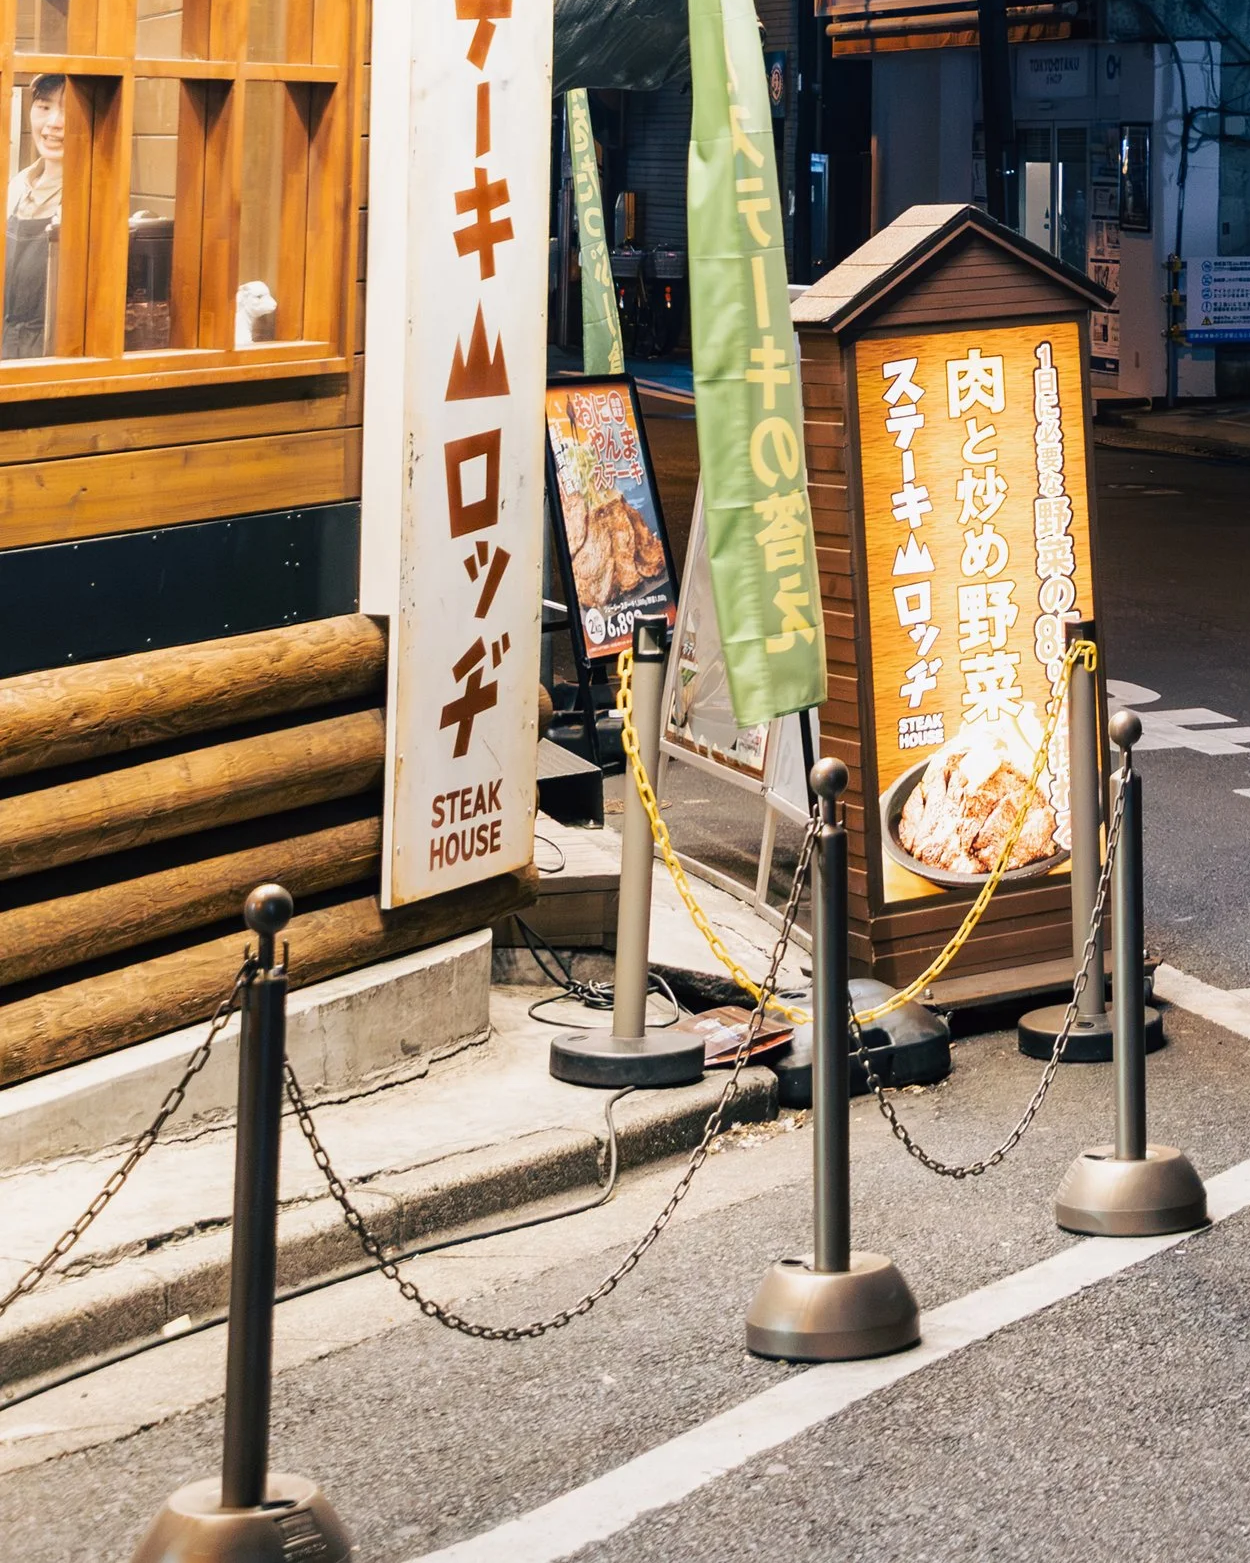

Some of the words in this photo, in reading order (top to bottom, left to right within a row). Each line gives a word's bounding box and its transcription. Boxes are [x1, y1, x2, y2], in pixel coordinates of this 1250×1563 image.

[588, 426, 639, 463] やんま
[881, 356, 935, 530] ステーキ
[593, 459, 645, 491] ステーキ
[945, 346, 1025, 723] 肉と炒め野菜
[606, 609, 643, 638] 6,89
[896, 711, 945, 731] STEAK
[897, 730, 945, 750] HOUSE
[430, 778, 504, 830] STEAK
[428, 819, 503, 873] HOUSE
